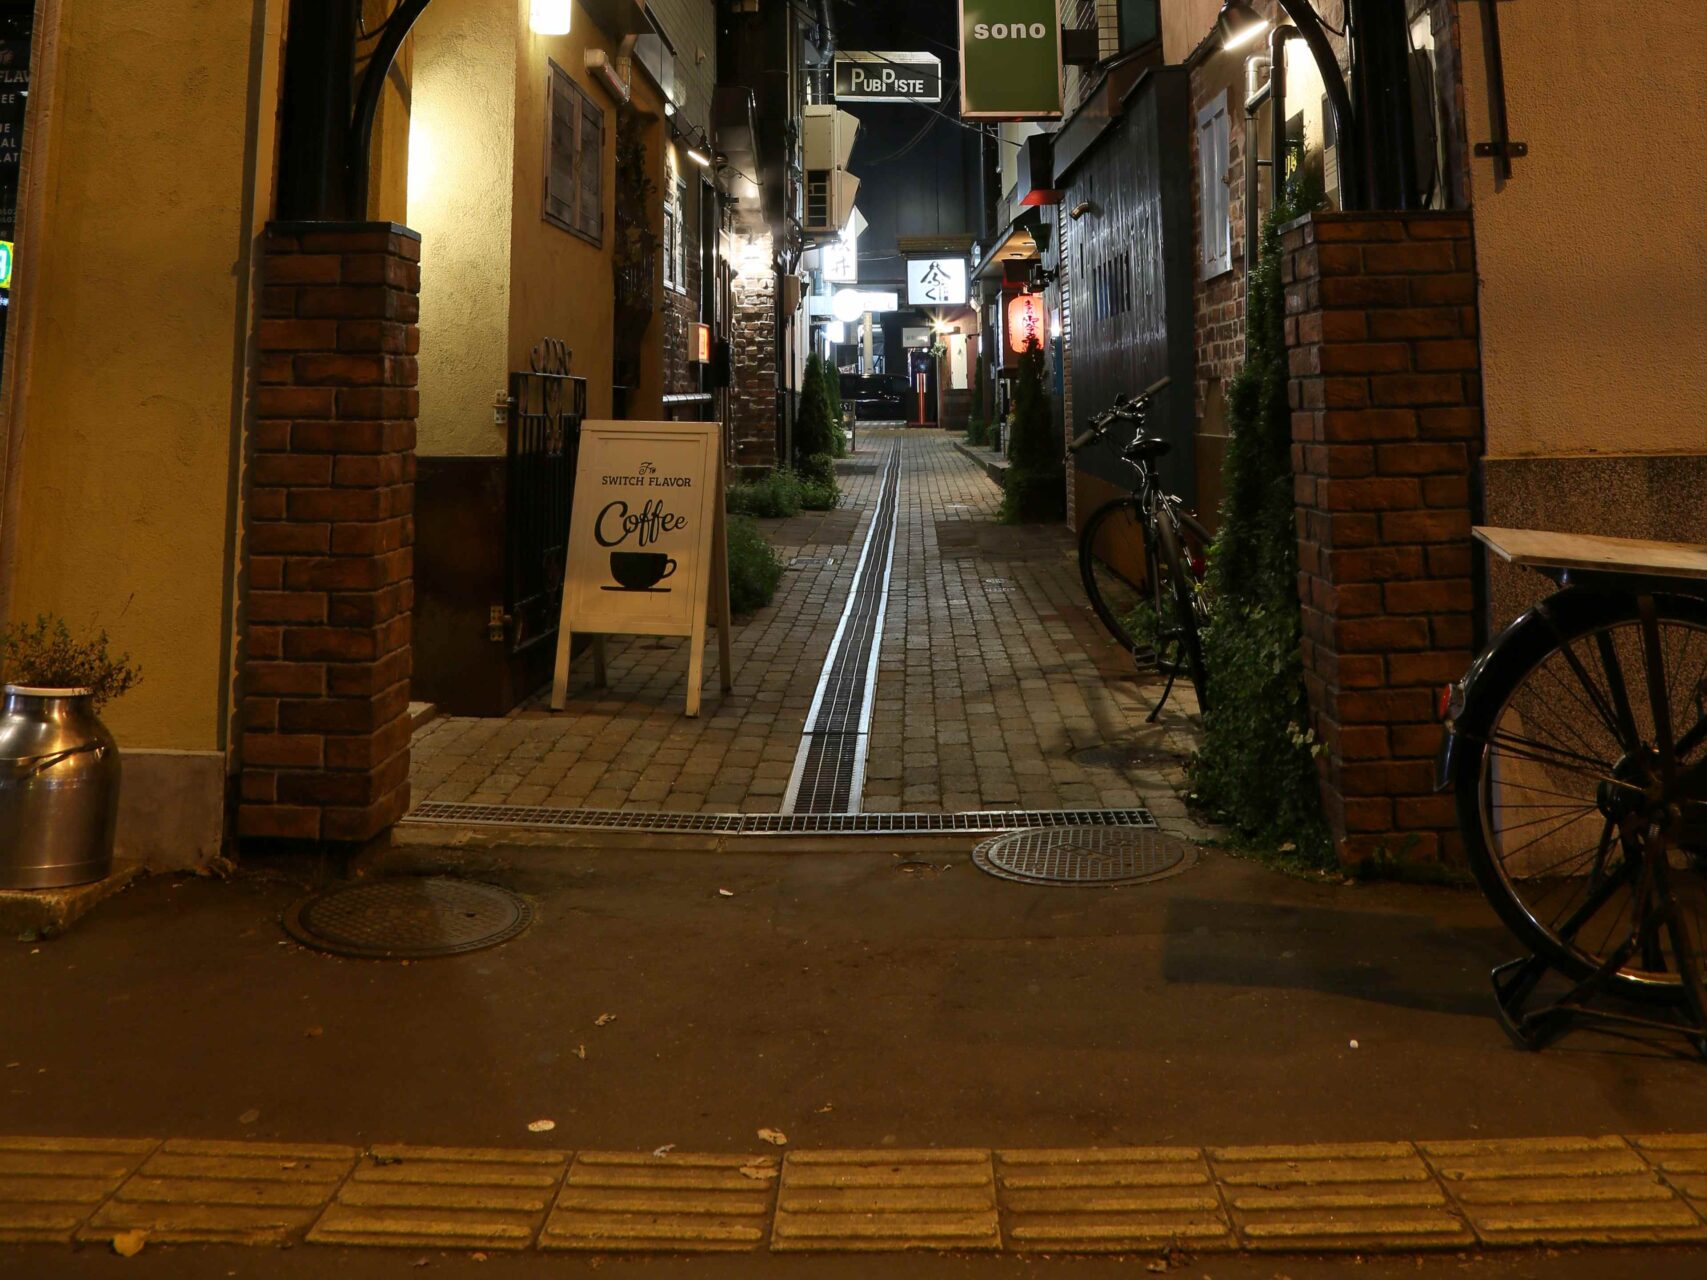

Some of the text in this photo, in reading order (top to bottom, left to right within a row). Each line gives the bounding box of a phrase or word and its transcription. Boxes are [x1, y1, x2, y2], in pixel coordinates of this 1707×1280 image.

[973, 22, 1047, 40] sono
[601, 475, 692, 488] SWITCH FLAVOR
[594, 499, 688, 547] Coffee
